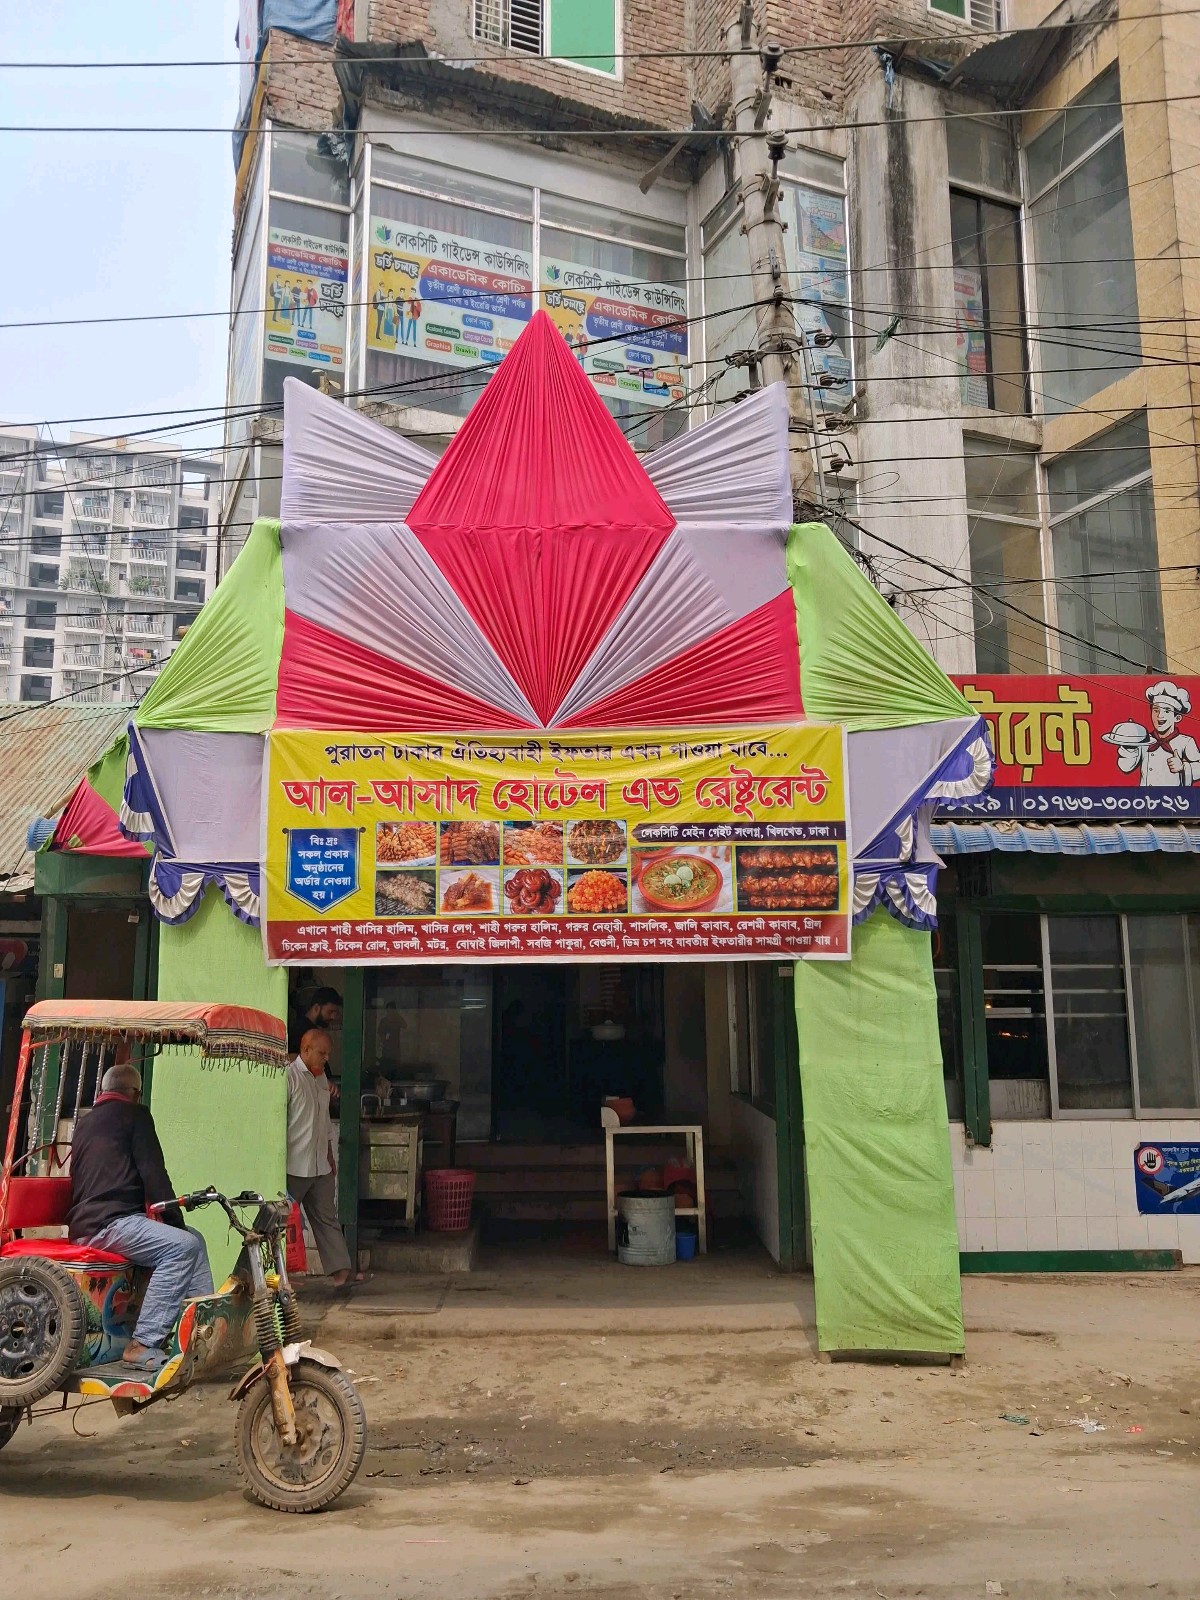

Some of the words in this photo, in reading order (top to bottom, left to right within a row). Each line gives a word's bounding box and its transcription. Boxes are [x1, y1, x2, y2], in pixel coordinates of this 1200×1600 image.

[396, 232, 438, 252] লেকসিটি
[442, 240, 481, 265] গাইডেন্স
[484, 250, 531, 278] কাউন্সিলিং
[428, 262, 488, 286] একাডেমিক
[492, 278, 528, 297] কোচিং
[563, 270, 602, 292] লেকসিটি
[606, 280, 641, 302] গাইডেন্স
[644, 288, 687, 312] কাউন্সিলিং
[593, 300, 648, 321] একাডেমিক
[426, 340, 451, 352] Graphics
[456, 345, 478, 357] Drawing
[324, 744, 385, 765] পুরাতন
[392, 743, 443, 762] ঢাকার
[450, 740, 542, 764] ঐতিহ্যবাহী
[549, 740, 612, 762] ইফতার
[620, 742, 662, 761] এখন
[668, 741, 723, 760] পাওয়া
[280, 774, 481, 816] আল-আসাদ
[492, 768, 610, 817] হোটেল
[622, 776, 683, 812] এন্ড
[694, 764, 831, 821] রেষ্টুরেন্ট
[1022, 795, 1190, 812] ০১৭৬৩-৩০০৮২৬
[310, 834, 324, 846] বিঃ
[326, 837, 338, 846] দ্রঃ
[642, 826, 678, 839] লেকসিটি
[682, 826, 705, 839] মেইন
[708, 825, 732, 838] গেইট
[734, 826, 764, 839] সংলগ্ন,
[808, 826, 829, 837] ঢাকা
[297, 850, 322, 860] সকল
[324, 850, 350, 860] প্রকার
[302, 860, 344, 874] অনুষ্ঠানের
[294, 874, 321, 886] অর্ডার
[323, 876, 352, 886] নেওয়া
[312, 890, 326, 900] হয়
[297, 925, 328, 936] এখানে
[330, 922, 352, 936] শাহী
[355, 922, 384, 935] খাসির
[386, 922, 418, 936] হালিম,
[420, 921, 449, 934] খাসির
[452, 923, 476, 936] লেগ,
[478, 920, 500, 934] শাহী
[504, 922, 527, 934] গরুর
[530, 920, 562, 934] হালিম,
[566, 922, 589, 932] গরুর
[592, 919, 626, 934] নেহারী,
[630, 919, 672, 933] শাসলিক,
[674, 919, 698, 932] জালি
[701, 920, 734, 932] কাবাব,
[736, 918, 766, 930] রেশমী
[768, 920, 800, 931] কাবাব,
[804, 918, 822, 930] গ্রিল
[282, 940, 308, 952] চিকেন
[310, 940, 332, 953] ফ্রাই,
[334, 938, 363, 952] চিকেন
[366, 940, 390, 953] রোল,
[392, 937, 424, 952] ডাবলী,
[426, 938, 449, 952] মটর,
[456, 938, 486, 950] বোম্বাই
[488, 936, 524, 951] জিলাপী,
[526, 936, 552, 949] সবজি
[590, 935, 620, 950] বেগুনী,
[622, 935, 640, 948] ডিম
[642, 938, 656, 948] চপ
[658, 938, 674, 948] সহ
[676, 934, 709, 948] যাবতীয়
[711, 934, 753, 948] ইফতারীর
[755, 933, 782, 946] সামগ্রী
[785, 935, 812, 946] পাওয়া
